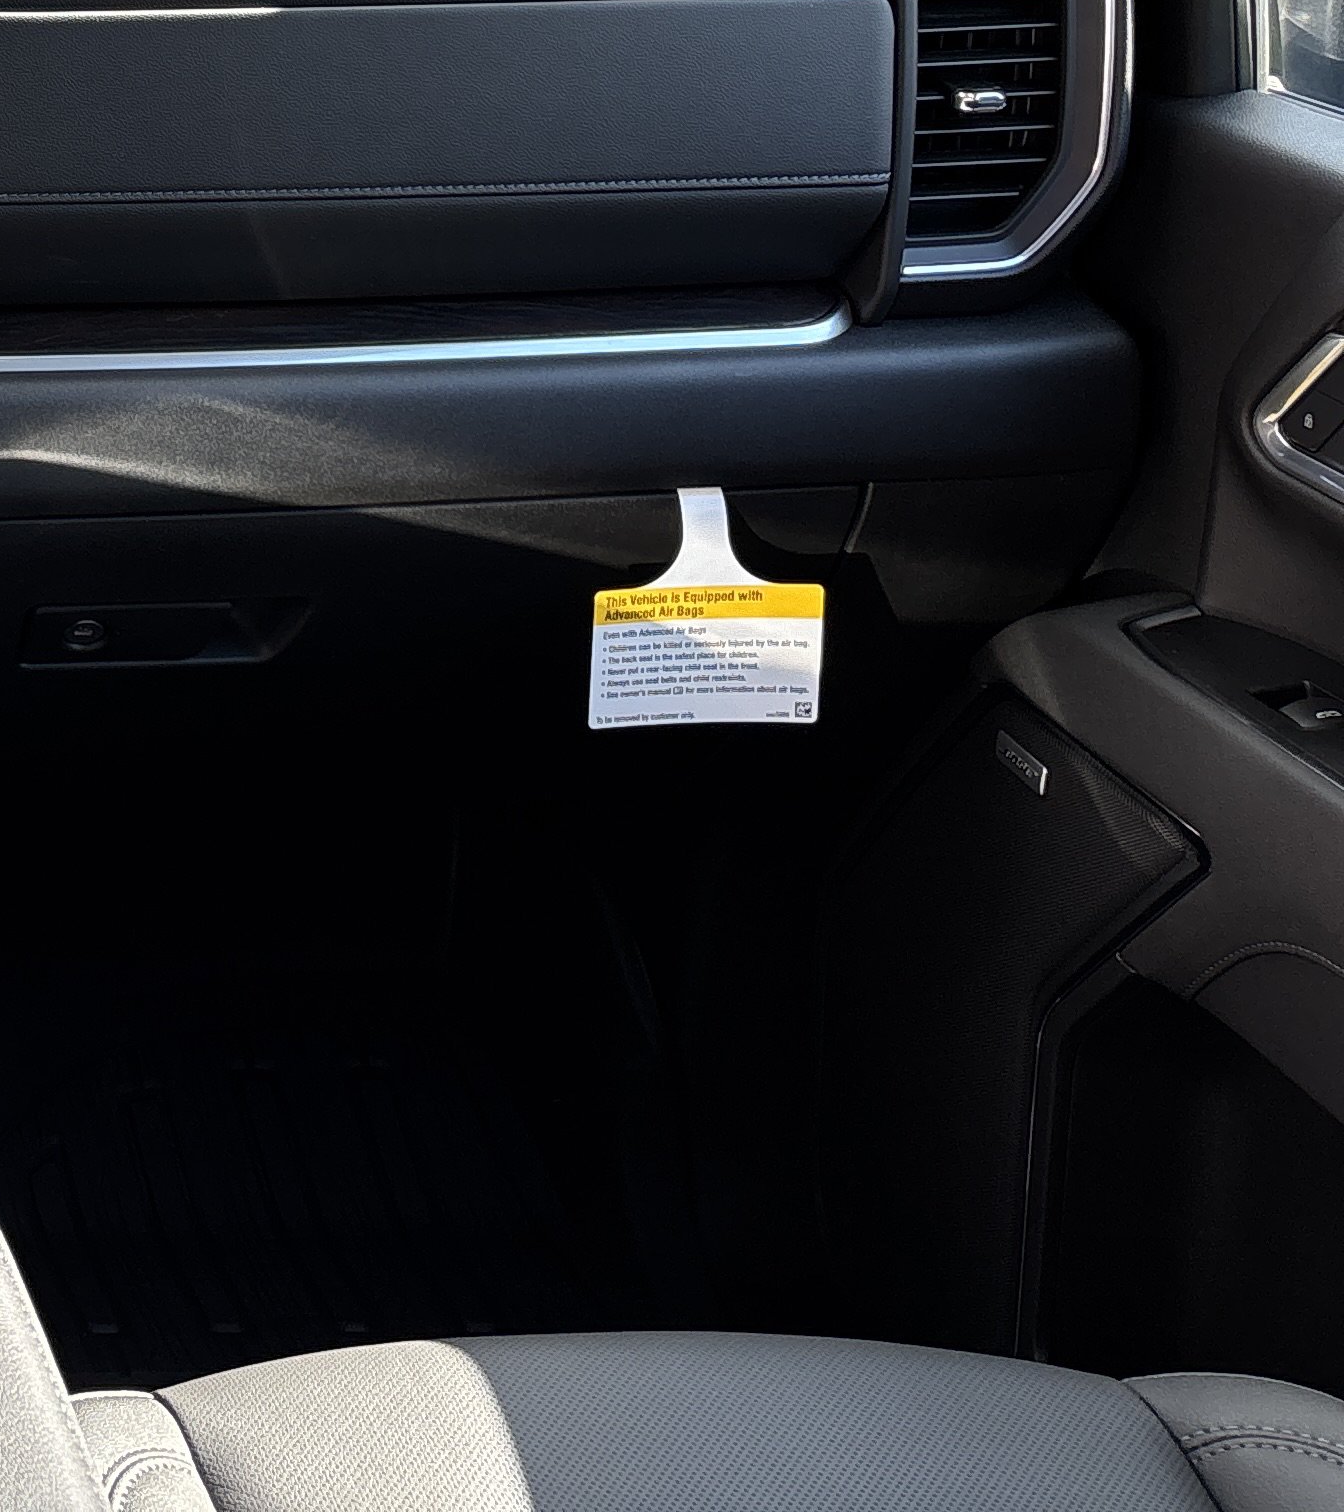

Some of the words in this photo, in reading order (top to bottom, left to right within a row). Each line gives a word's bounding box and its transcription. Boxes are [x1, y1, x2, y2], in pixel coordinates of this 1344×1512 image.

[606, 596, 627, 608] This
[630, 593, 668, 605] Vehicle
[683, 590, 734, 605] Equipped
[737, 589, 763, 601] with
[604, 608, 655, 621] Advanced
[659, 606, 675, 617] Air
[677, 605, 704, 618] Bags
